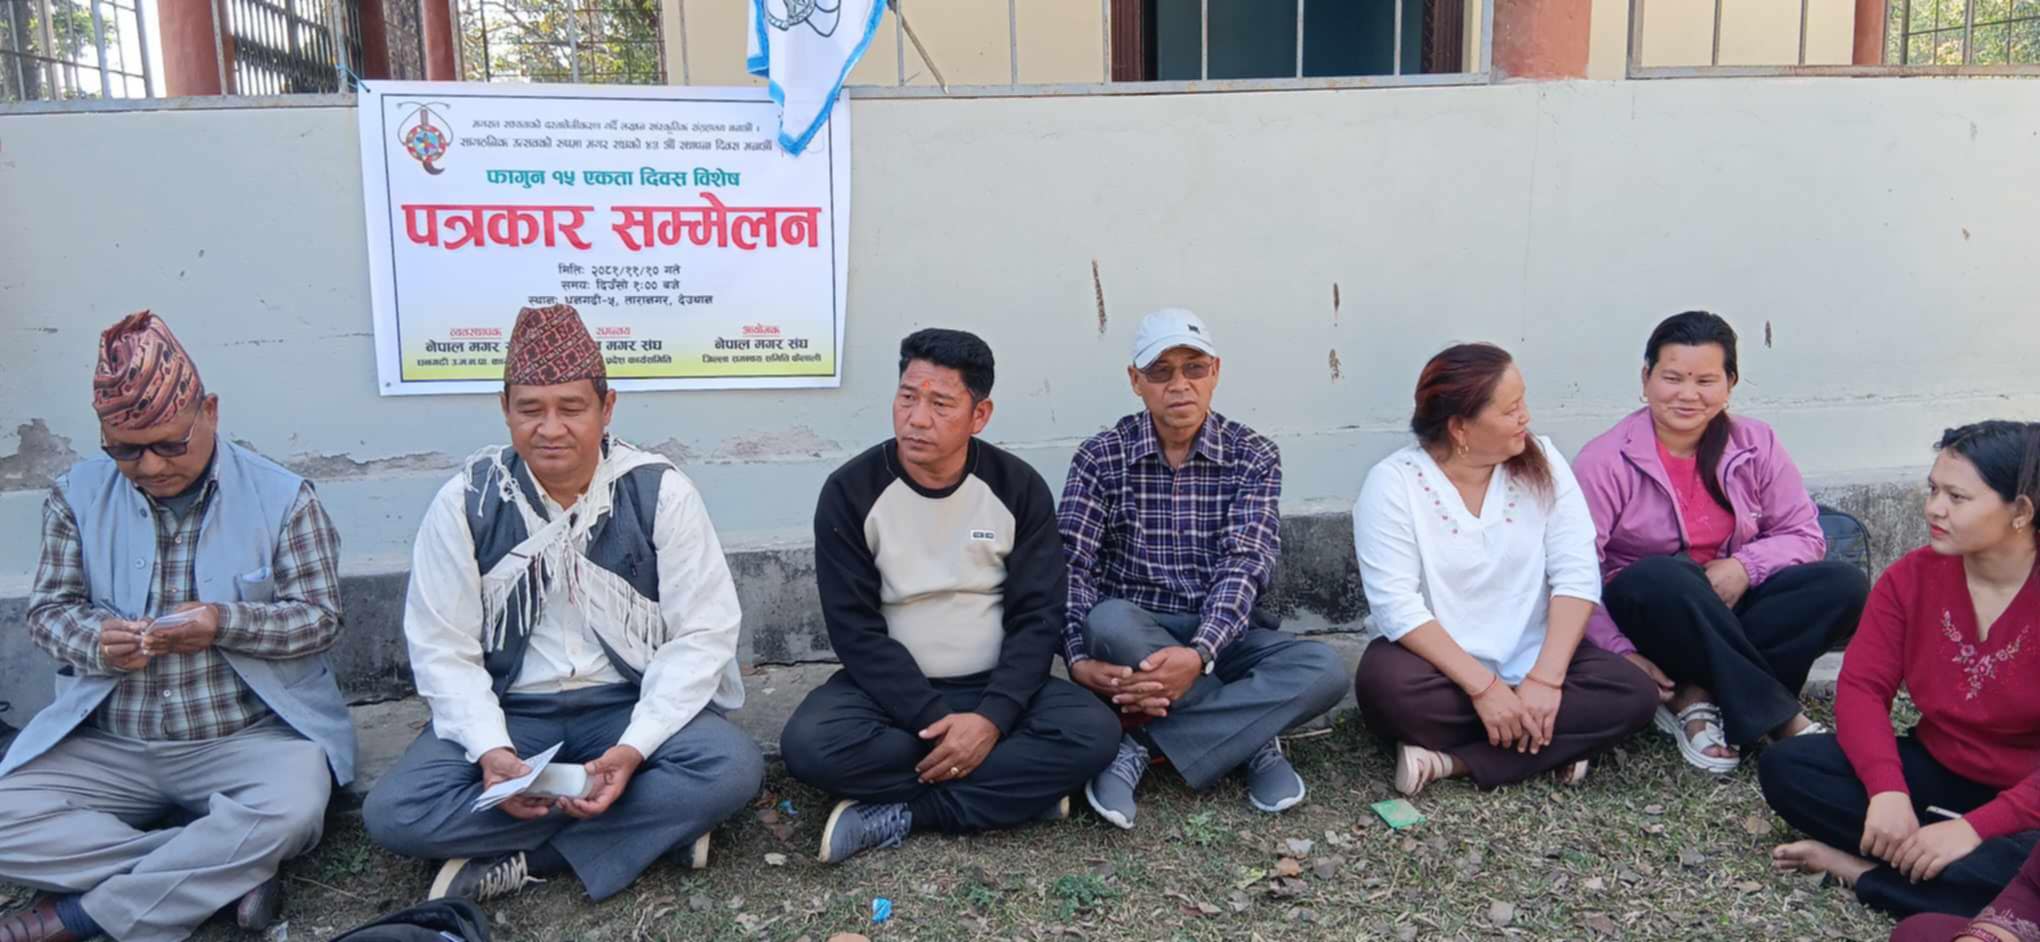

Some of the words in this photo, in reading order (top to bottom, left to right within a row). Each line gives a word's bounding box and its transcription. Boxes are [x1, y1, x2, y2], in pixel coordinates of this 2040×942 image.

[715, 138, 740, 151] दिवस
[486, 169, 546, 189] फागुन
[552, 170, 576, 186] १५
[583, 170, 633, 187] एकता
[640, 166, 688, 187] दिवस
[693, 167, 741, 187] विशेष
[401, 204, 594, 250] पत्रकार
[611, 192, 822, 251] सम्मेलन
[425, 339, 464, 353] नेपाल
[468, 341, 500, 353] मगर
[606, 340, 637, 352] मगर
[640, 339, 663, 352] संघ
[714, 337, 750, 350] नेपाल
[754, 338, 785, 350] मगर
[787, 337, 809, 350] संघ
